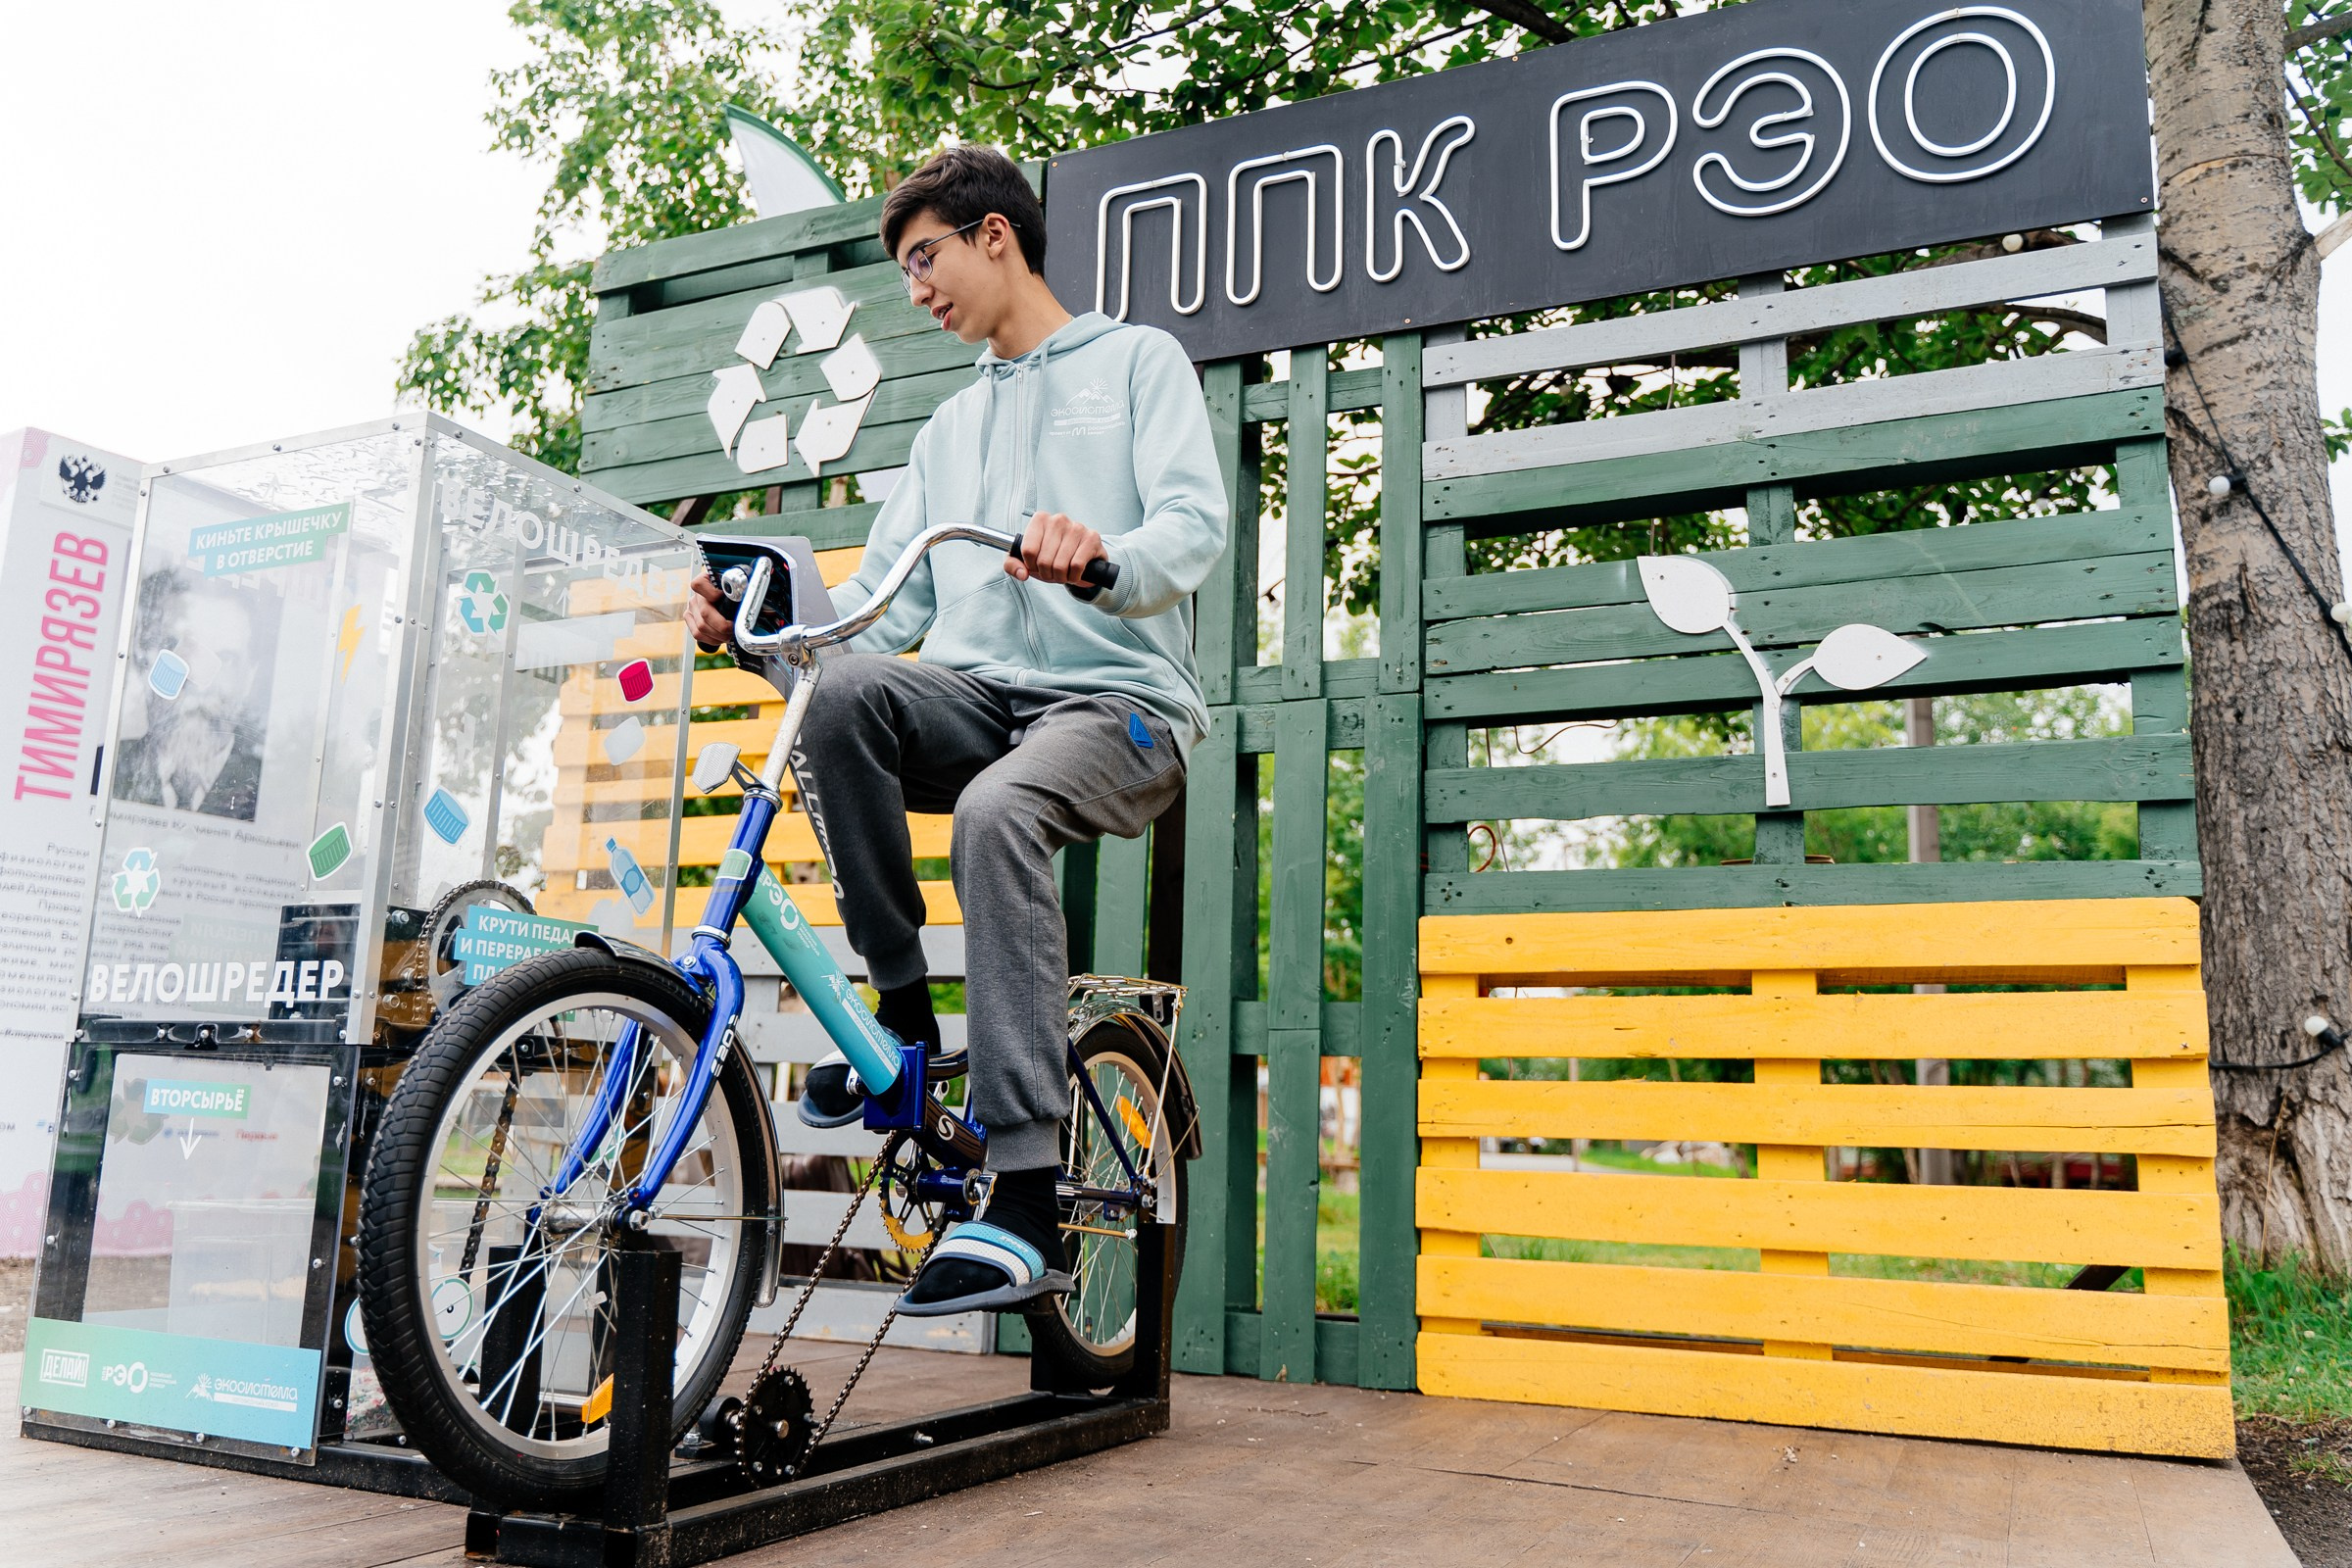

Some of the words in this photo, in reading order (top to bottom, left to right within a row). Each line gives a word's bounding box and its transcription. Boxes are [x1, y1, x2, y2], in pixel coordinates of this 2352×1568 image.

[1095, 115, 1476, 322] ППК
[1549, 4, 2056, 251] РЭО
[195, 524, 253, 551] КИНЬТЕ
[254, 511, 343, 540] КРЫШЕЧКУ
[439, 476, 685, 604] ВЕЛОШРЕДЕР
[216, 554, 226, 570] В
[227, 540, 315, 569] ОТВЕРСТИЕ
[14, 531, 110, 801] ТИМИРЯЗЕВ
[460, 937, 472, 955] И
[478, 914, 529, 938] КРУТИ
[88, 959, 346, 1009] ВЕЛОШРЕДЕР
[150, 1087, 245, 1113] ВТОРСЫРЬЁ
